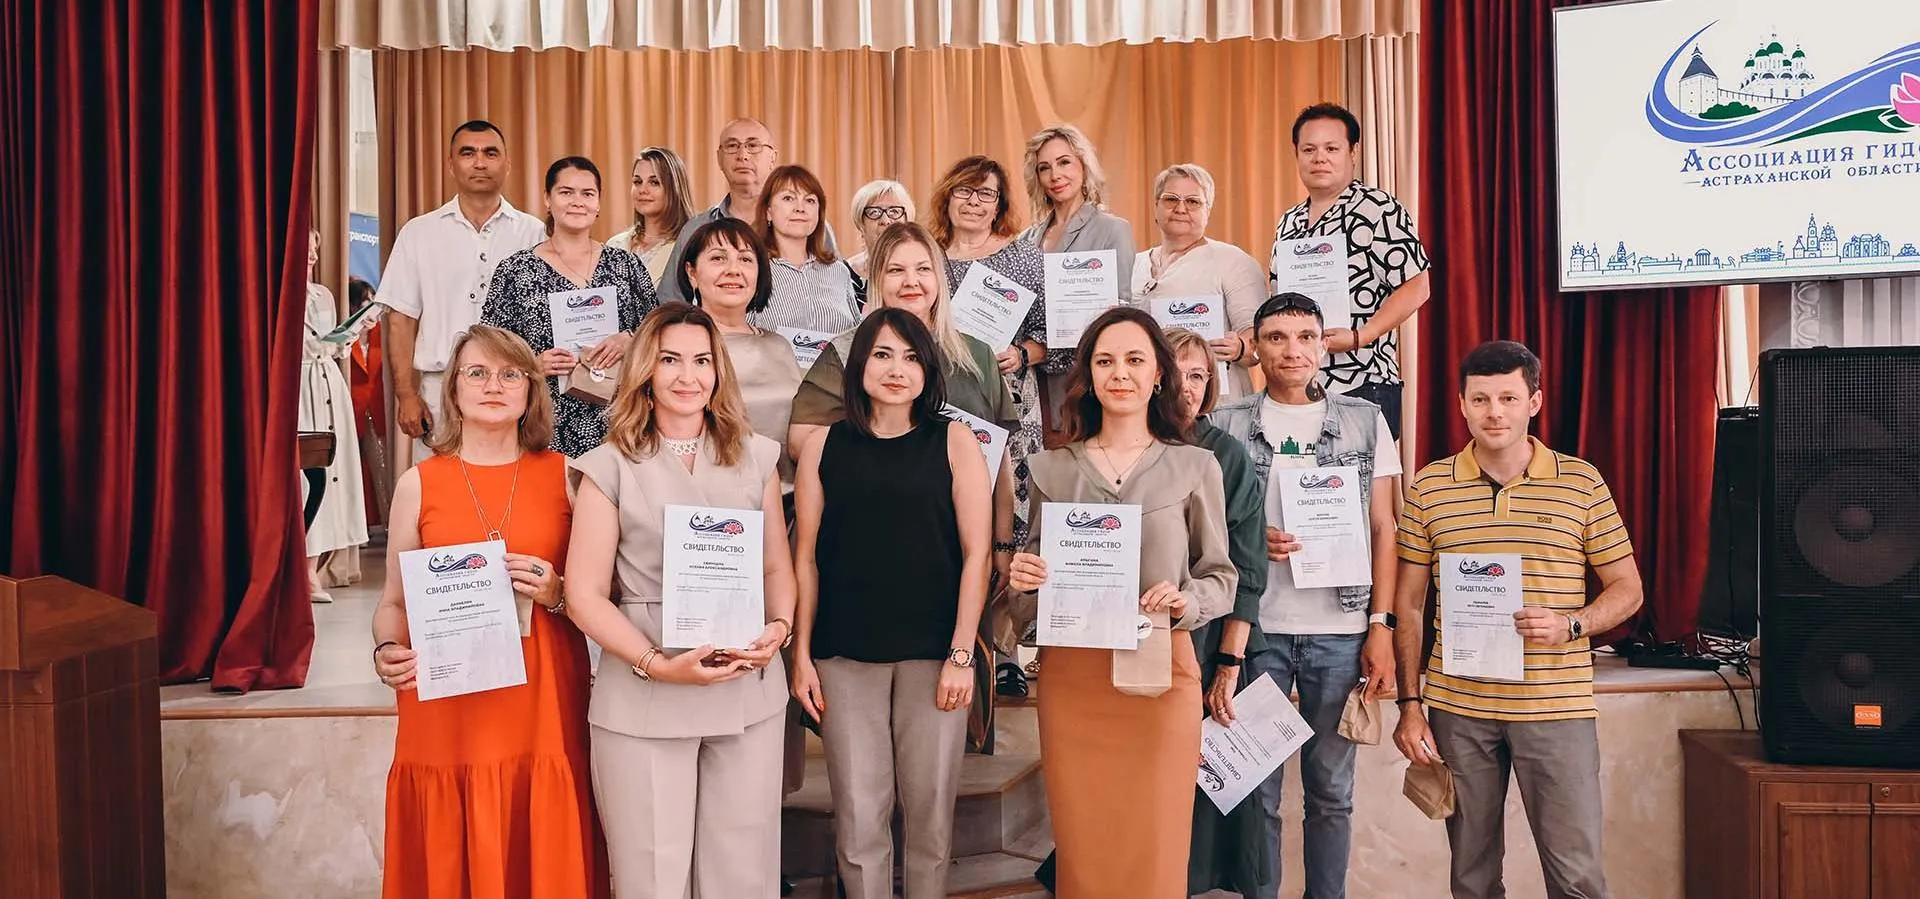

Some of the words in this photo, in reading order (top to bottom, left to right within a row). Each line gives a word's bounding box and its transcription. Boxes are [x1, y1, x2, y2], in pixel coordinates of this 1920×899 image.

[1680, 147, 1854, 172] АССОЦИАЦИЯ
[1866, 142, 1920, 159] ГИД
[1701, 166, 1832, 188] АСТРАХАНСКОЙ
[682, 542, 745, 554] СВИДЕТЕЛЬСТВО
[1059, 539, 1122, 549] СВИДЕТЕЛЬСТВО
[425, 579, 492, 595] СВИДЕТЕЛЬСТВО
[1455, 584, 1506, 593] СВИДЕТЕЛЬСТВО
